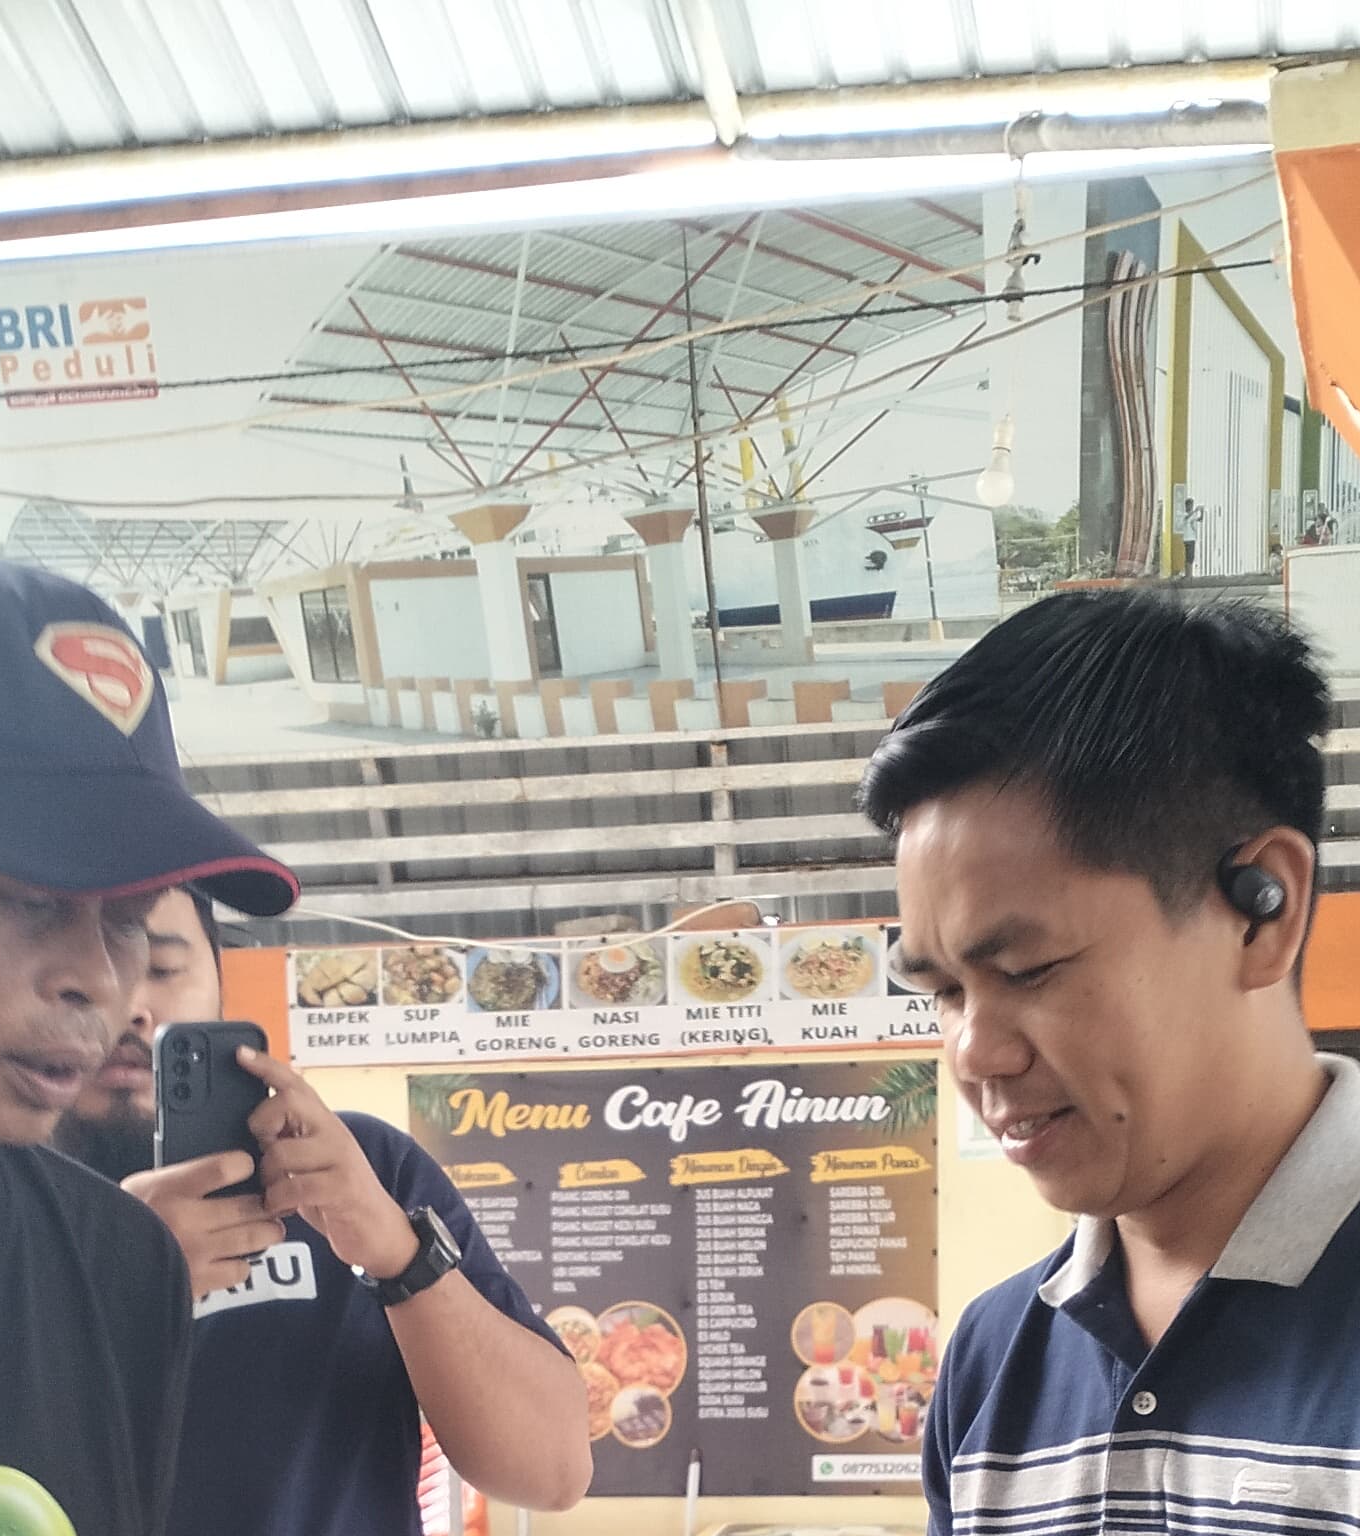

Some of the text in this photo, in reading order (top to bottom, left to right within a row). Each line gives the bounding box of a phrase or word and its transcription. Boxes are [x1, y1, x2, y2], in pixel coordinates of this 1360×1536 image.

[0, 344, 156, 383] Peduli
[404, 1008, 440, 1022] SUP
[686, 1004, 762, 1021] MIE TITI
[812, 1003, 848, 1016] MIE
[307, 1011, 369, 1025] EMPEK
[496, 1015, 529, 1028] MIE
[593, 1011, 640, 1026] NASI
[307, 1033, 369, 1047] EMPEK
[385, 1031, 461, 1046] LUMPIA
[680, 1029, 769, 1047] (KERING)
[801, 1025, 859, 1040] KUAH
[475, 1036, 557, 1051] GORENG
[578, 1033, 661, 1049] GORENG
[448, 1079, 891, 1142] Menu Cafe Ainun
[823, 1153, 919, 1172] Minuman Panas
